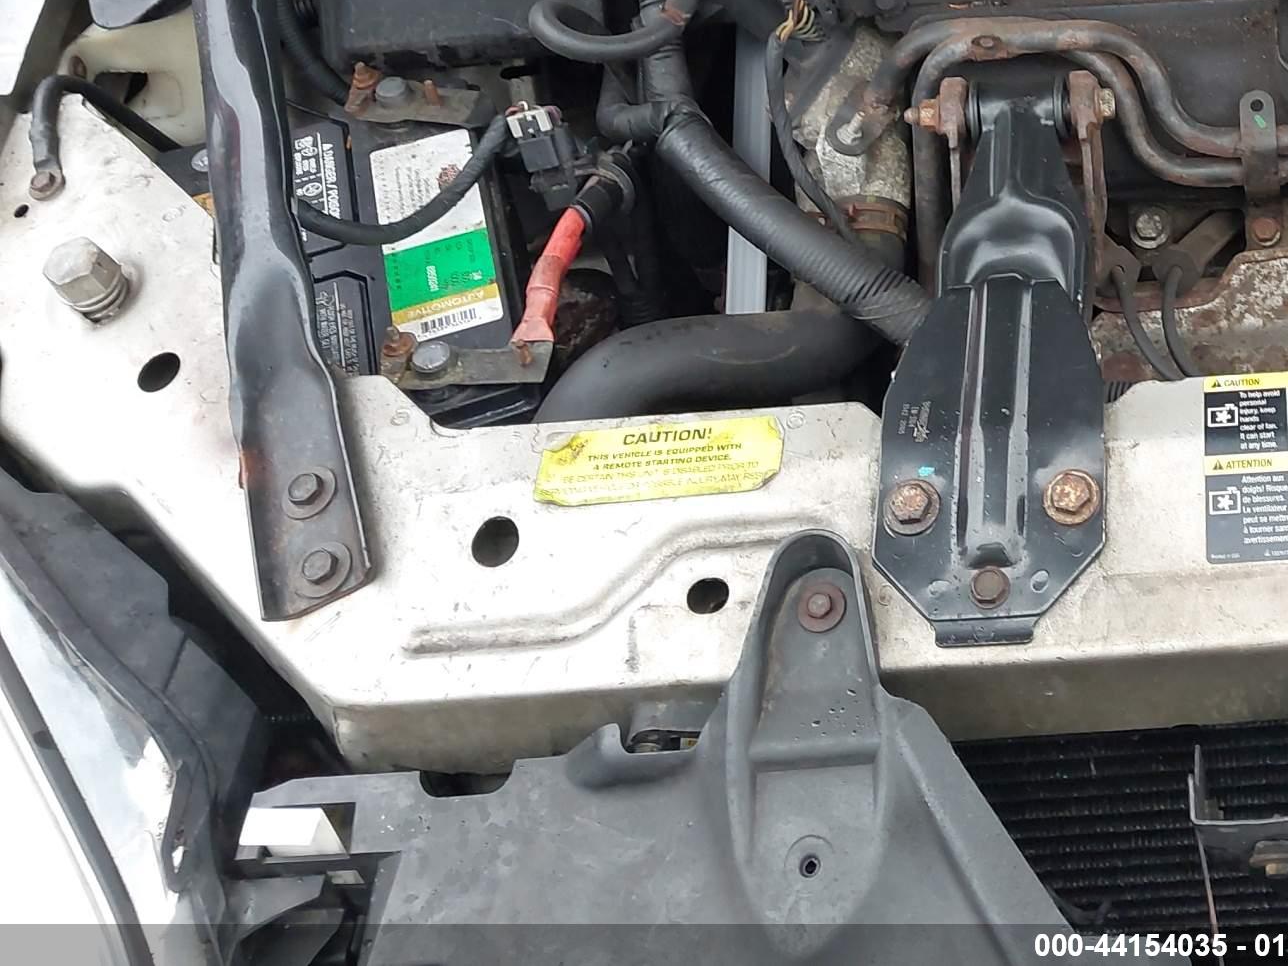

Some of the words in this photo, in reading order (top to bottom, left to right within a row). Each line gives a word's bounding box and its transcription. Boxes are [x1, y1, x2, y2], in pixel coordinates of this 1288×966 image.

[324, 150, 336, 184] DANGER
[407, 290, 484, 317] AUTOMOTIVE
[1224, 378, 1260, 386] CAUTION
[1239, 399, 1267, 407] personal
[623, 428, 712, 445] CAUTION!
[613, 450, 652, 459] VEHICLE
[667, 445, 713, 455] EQUIPPED
[717, 443, 742, 451] WITH
[603, 462, 642, 470] REMOTE
[645, 458, 692, 466] STARTING
[695, 454, 731, 462] DEVICE.
[1226, 459, 1272, 469] ATTENTION
